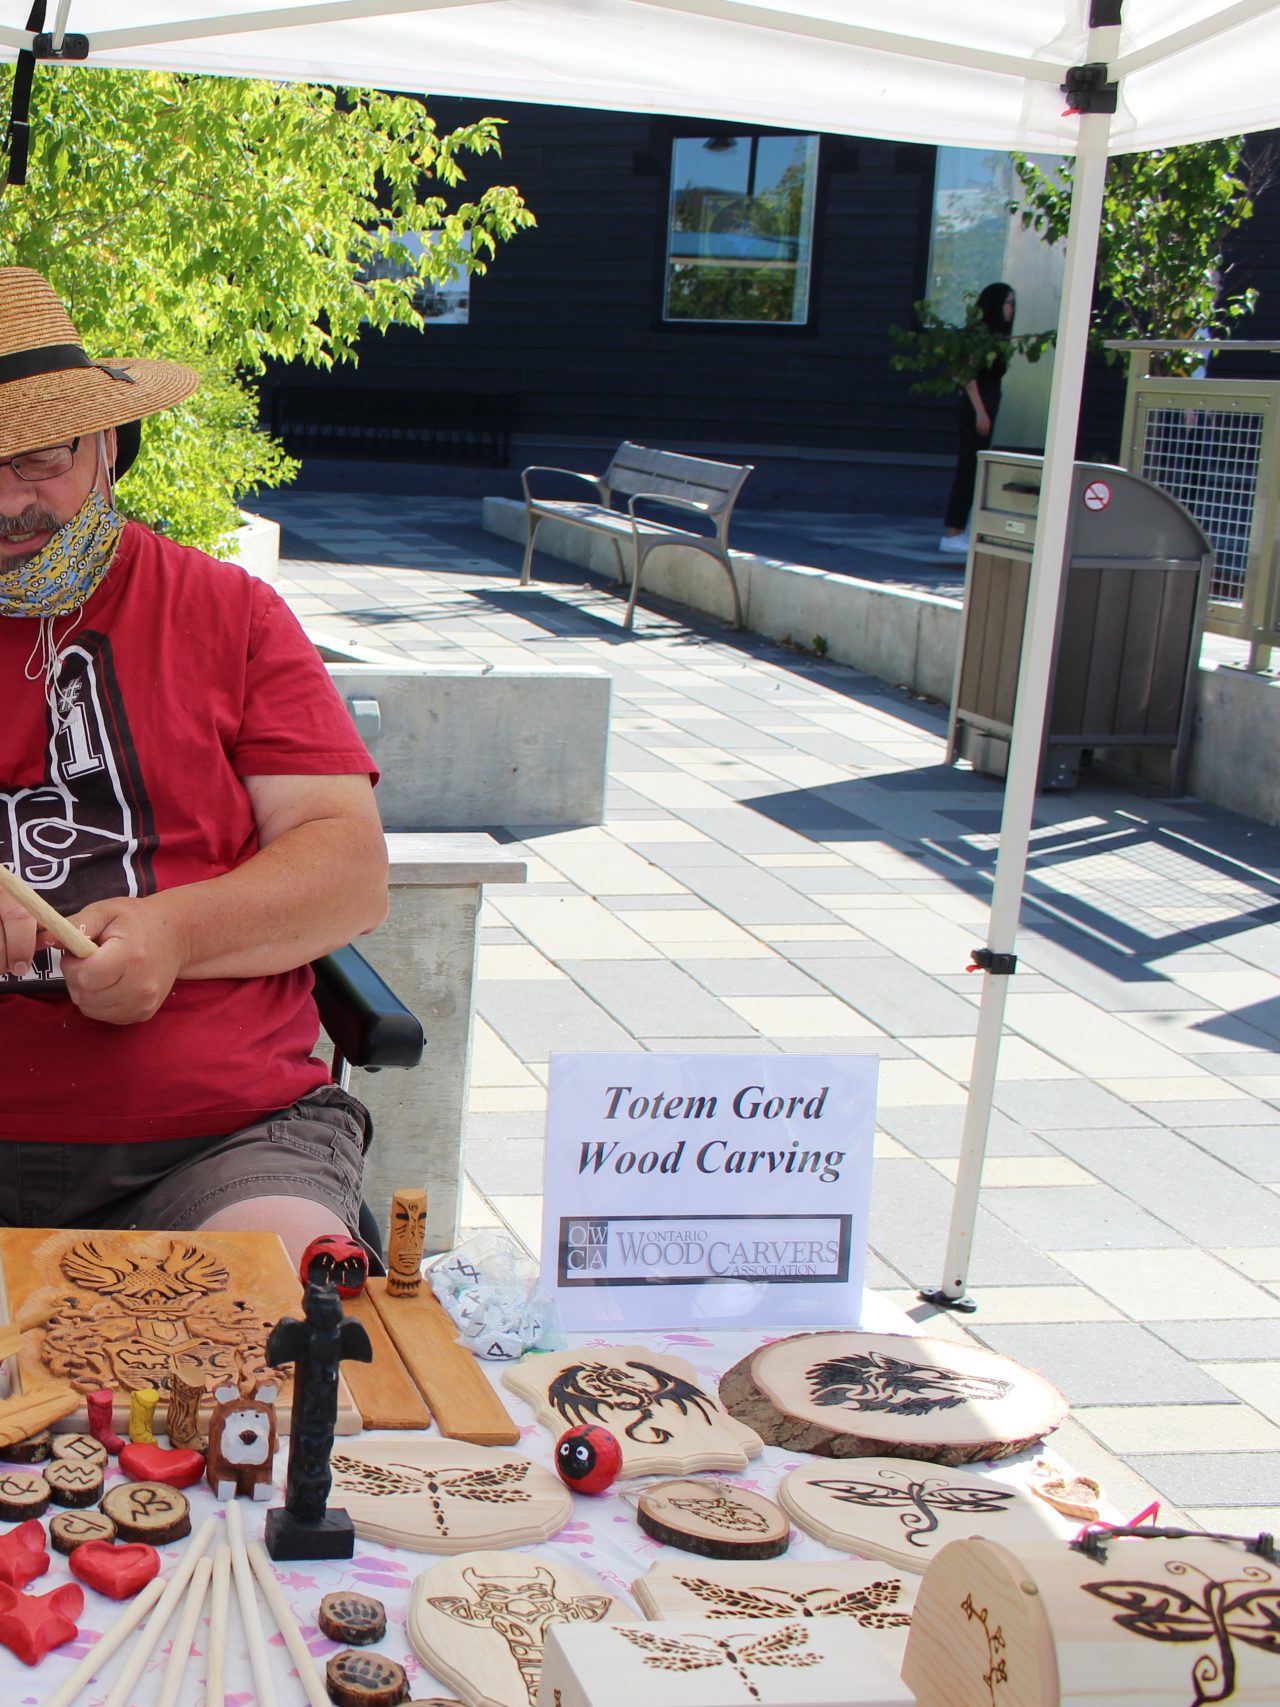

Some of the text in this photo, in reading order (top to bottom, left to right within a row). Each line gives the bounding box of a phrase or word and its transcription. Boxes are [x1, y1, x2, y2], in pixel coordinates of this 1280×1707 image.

[603, 1085, 830, 1120] Totem Gord
[577, 1140, 846, 1183] Wood Carving
[616, 1231, 839, 1275] WOOD CARVERS
[646, 1230, 708, 1242] ONTARIO
[730, 1264, 817, 1276] ASSOCIATION
